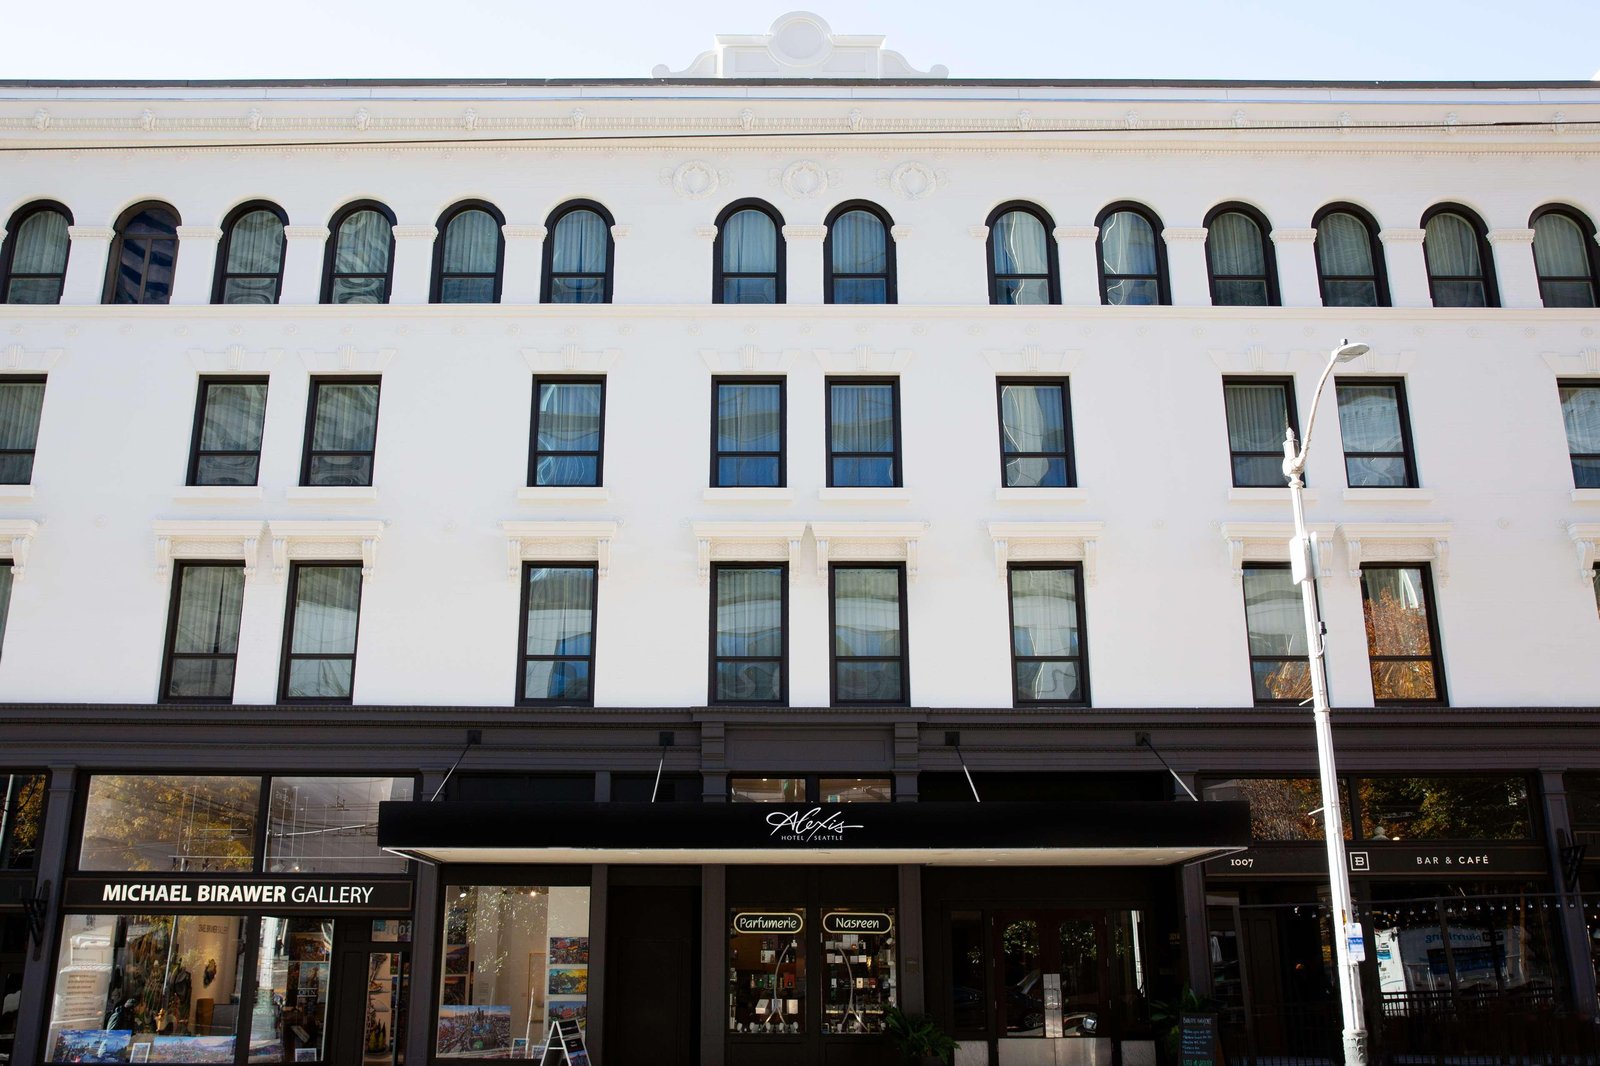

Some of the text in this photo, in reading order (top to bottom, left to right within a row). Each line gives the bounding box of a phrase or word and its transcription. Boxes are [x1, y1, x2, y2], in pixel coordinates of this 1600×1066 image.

[766, 807, 864, 842] Alexis
[1230, 858, 1254, 868] 1007
[1416, 854, 1489, 865] BAR & CAFÉ
[102, 884, 374, 904] MICHAEL BIRAWER GALLERY
[739, 916, 797, 929] Parfumerie
[835, 917, 880, 928] Nasreen
